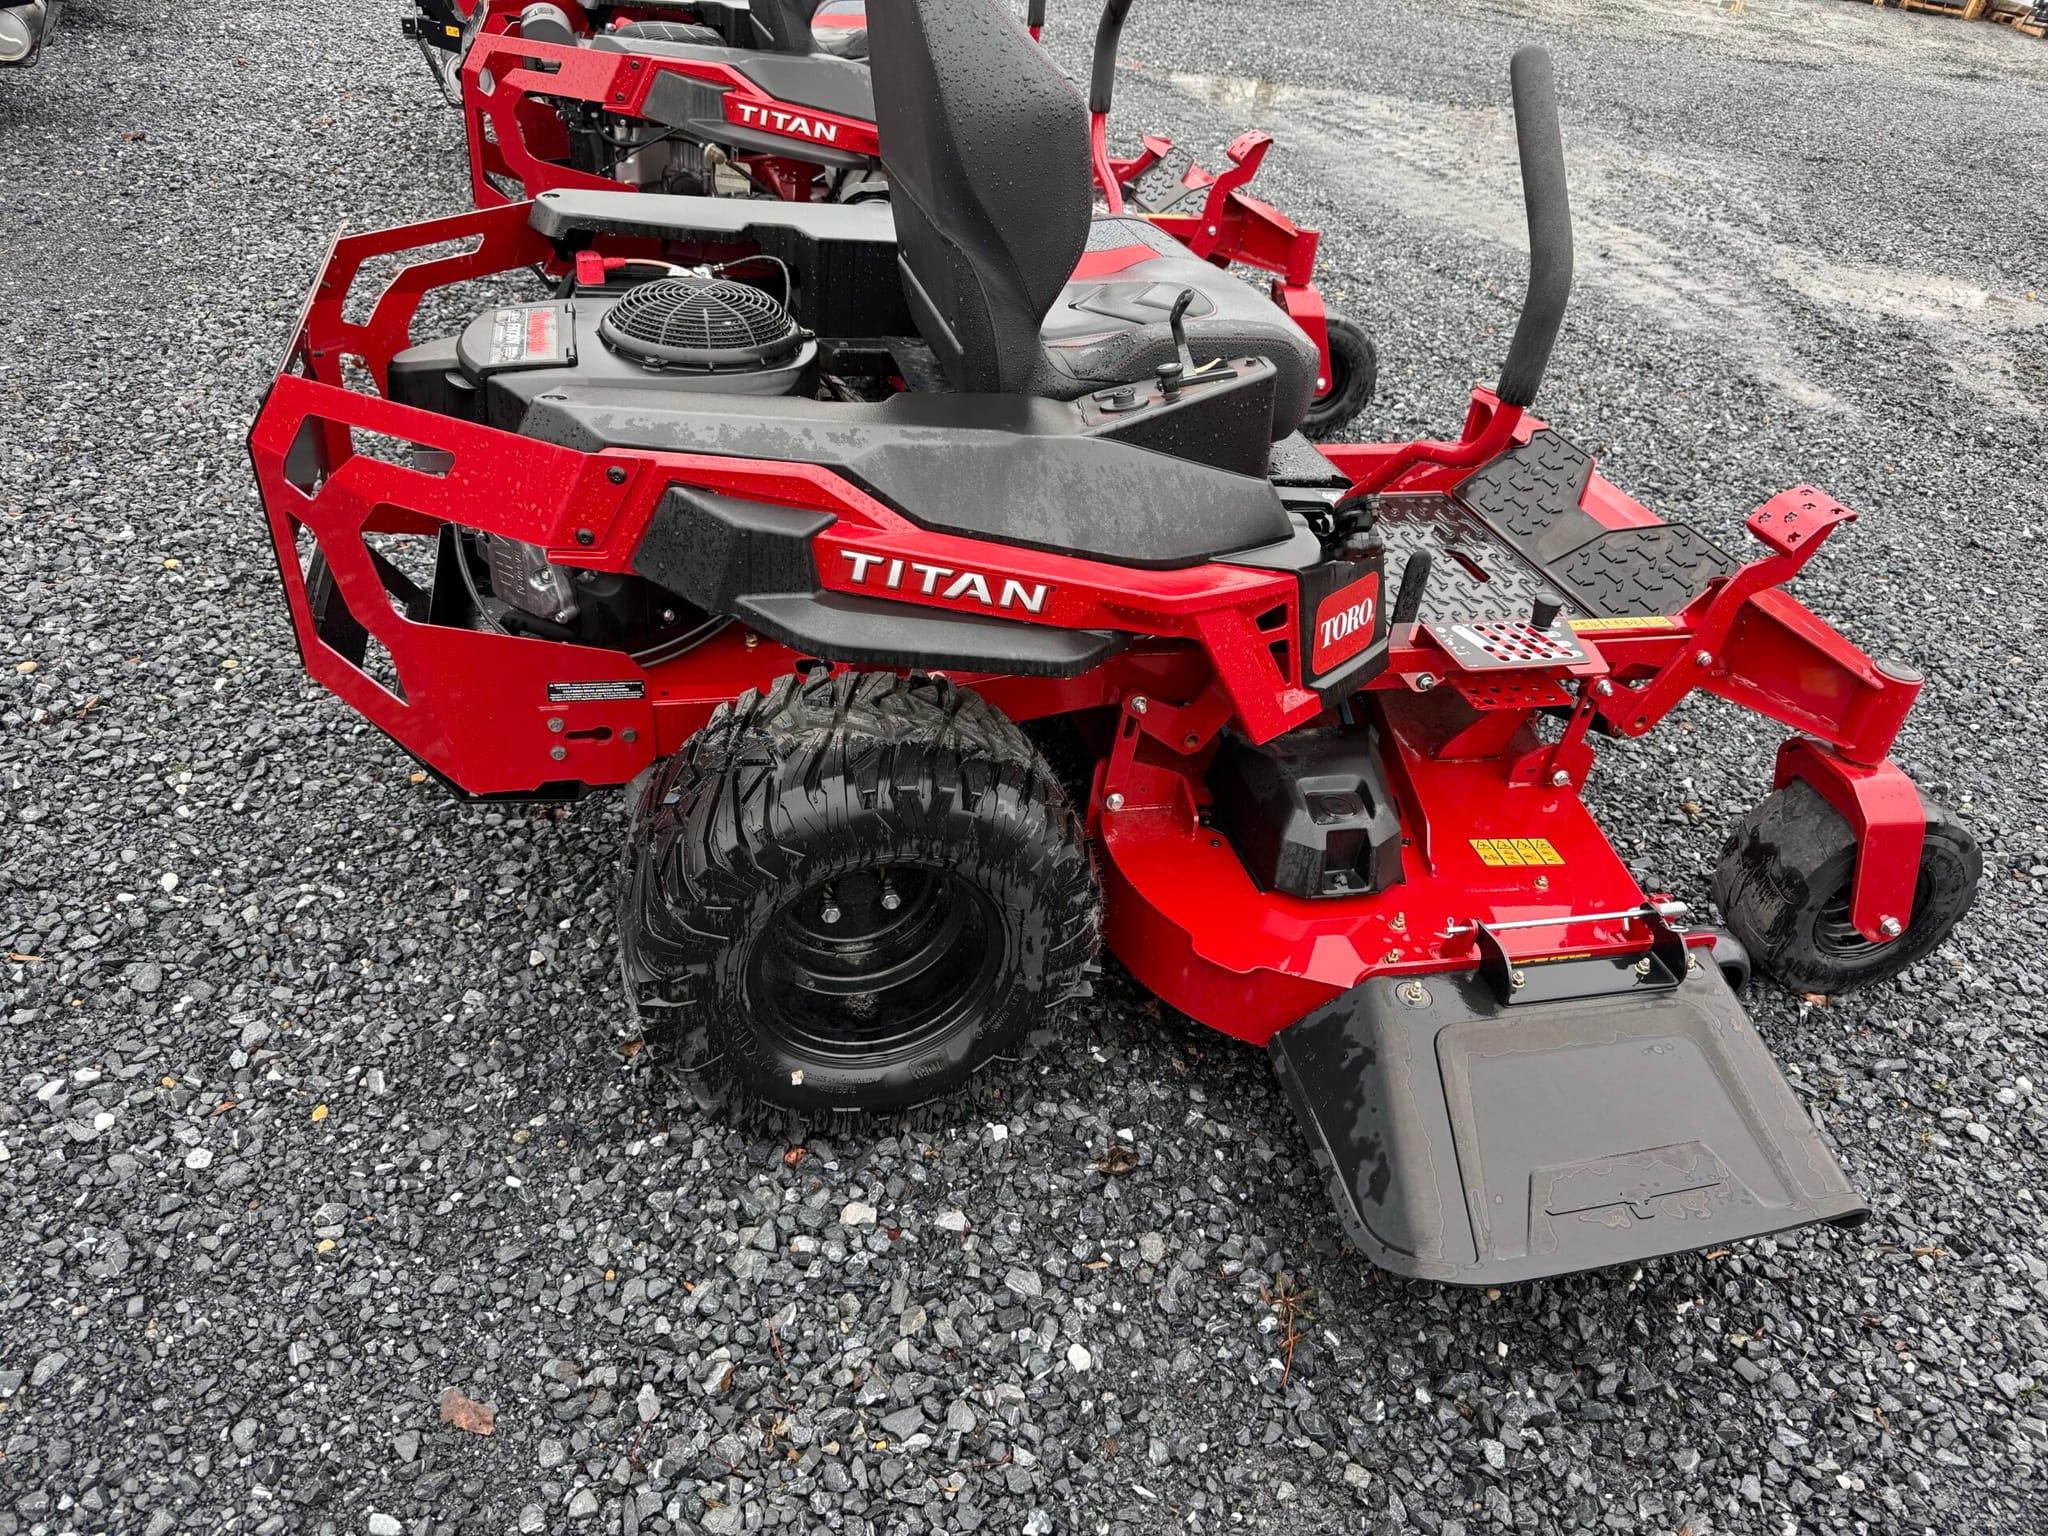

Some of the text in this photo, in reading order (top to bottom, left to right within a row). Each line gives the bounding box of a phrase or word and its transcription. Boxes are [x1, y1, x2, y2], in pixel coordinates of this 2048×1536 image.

[737, 103, 837, 142] TITAN
[840, 549, 1048, 613] TITAN
[1320, 597, 1373, 649] TORO
